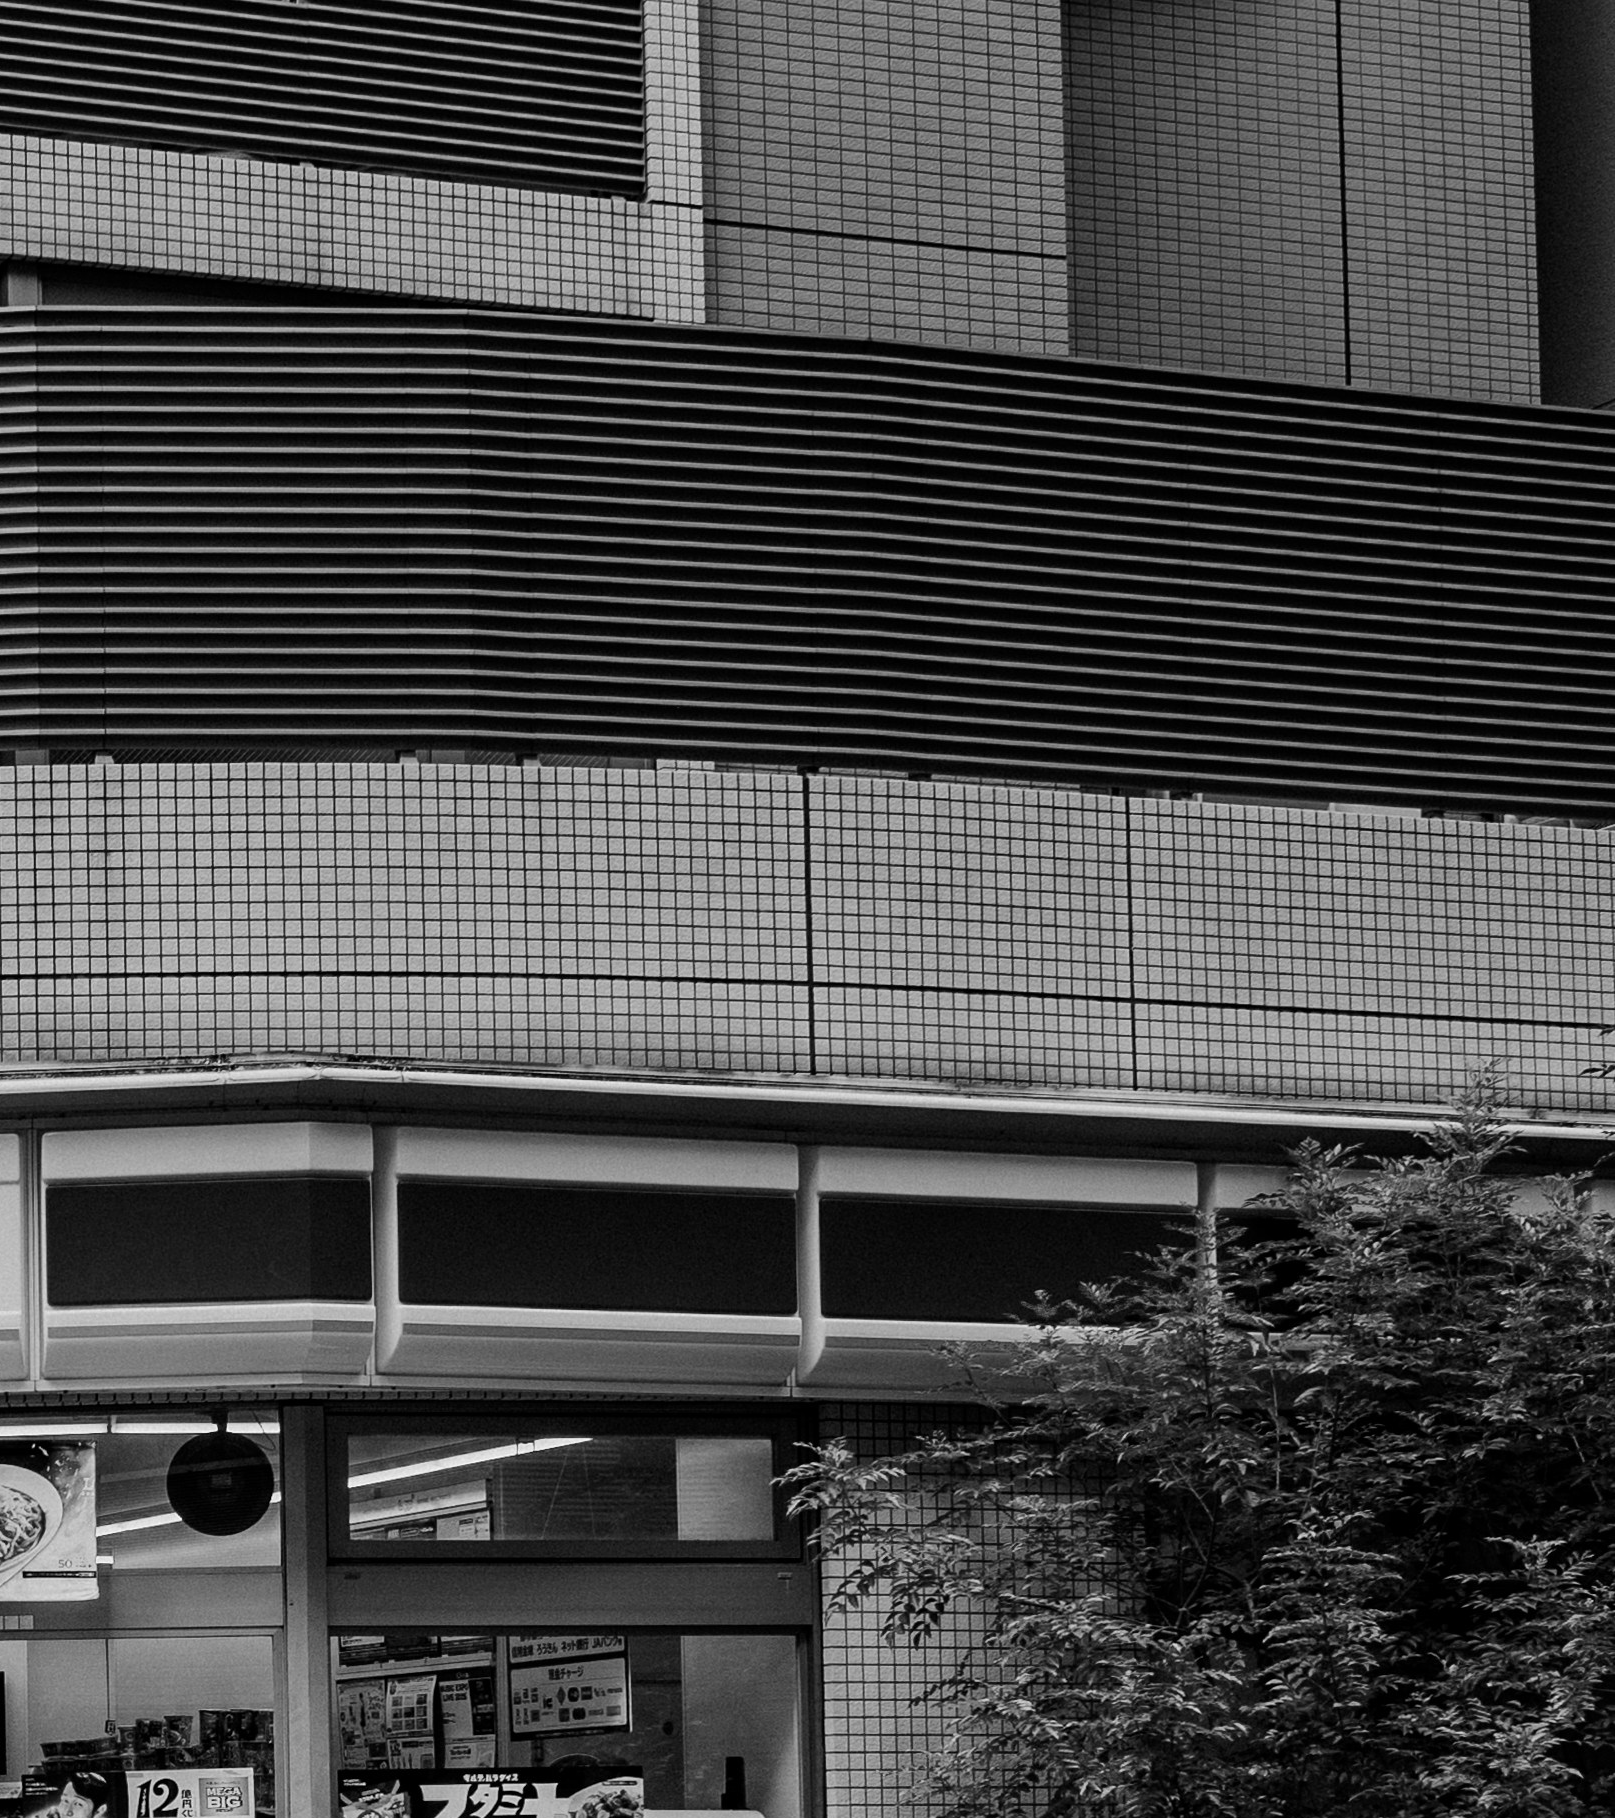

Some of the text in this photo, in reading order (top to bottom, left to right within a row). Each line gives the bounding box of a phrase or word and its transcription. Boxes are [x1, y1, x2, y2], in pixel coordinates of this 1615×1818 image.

[137, 1778, 179, 1818] 12
[206, 1787, 242, 1798] MEGA
[207, 1797, 242, 1809] BIG
